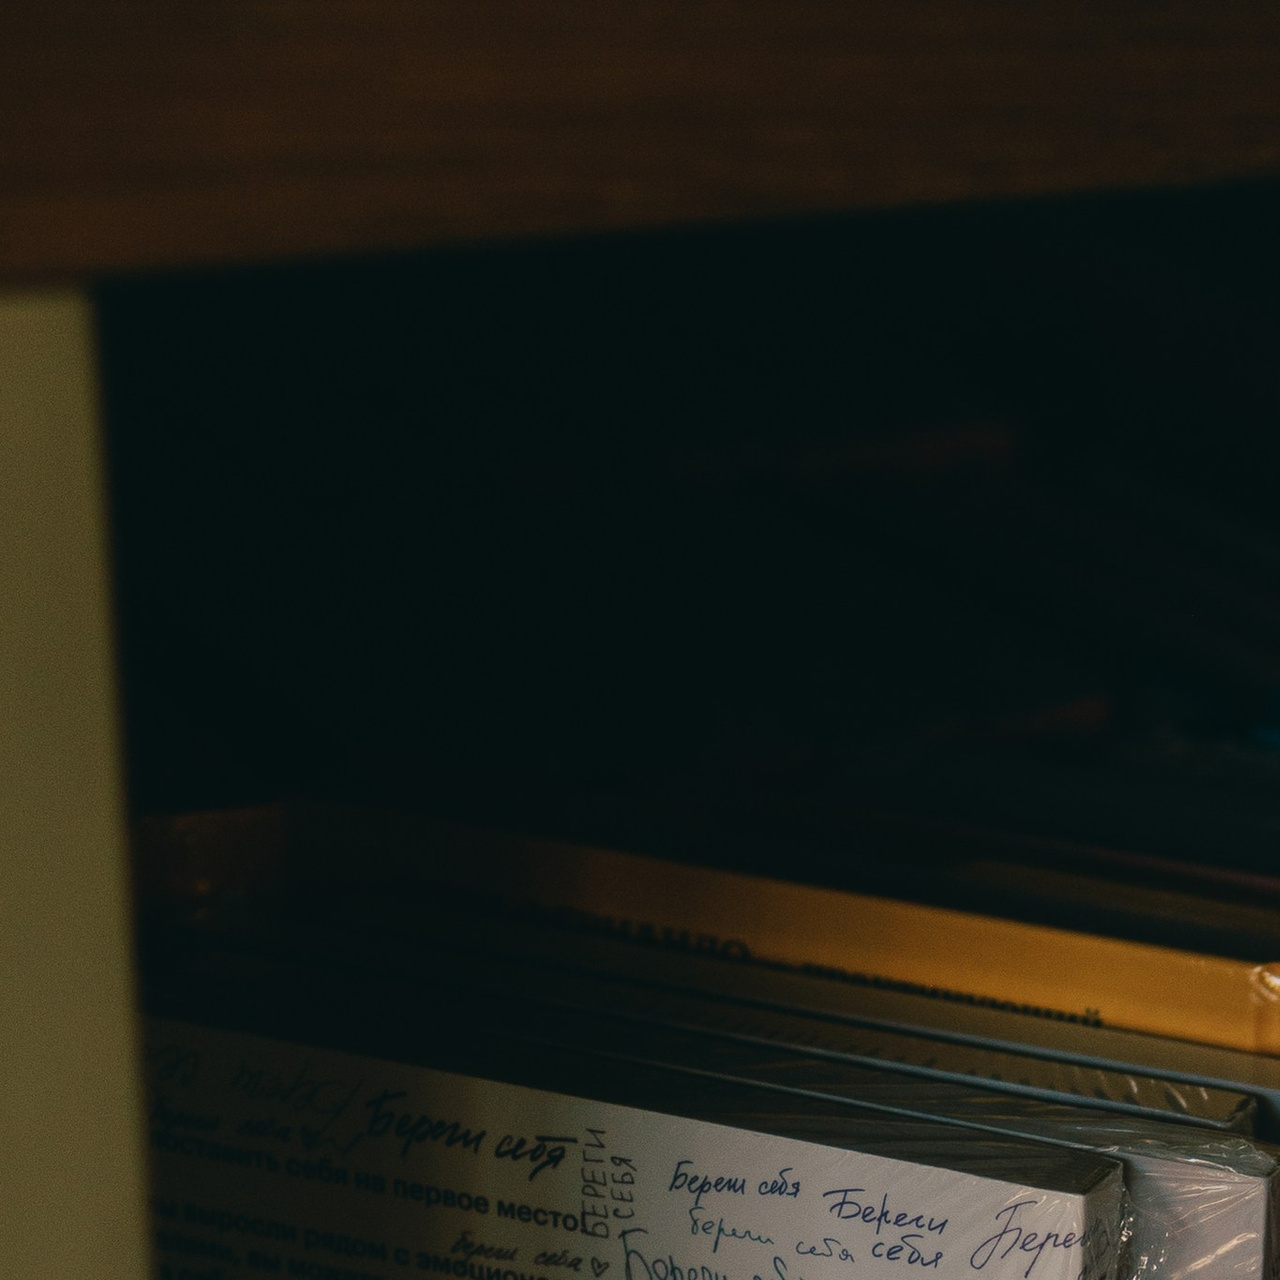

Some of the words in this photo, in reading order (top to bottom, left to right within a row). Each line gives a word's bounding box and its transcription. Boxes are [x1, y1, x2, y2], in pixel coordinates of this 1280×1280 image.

[366, 1089, 486, 1157] Береги
[495, 1134, 578, 1181] себя
[284, 1154, 349, 1186] себя
[352, 1168, 385, 1193] на
[391, 1175, 490, 1214] первое
[496, 1196, 584, 1232] место!
[581, 1127, 609, 1239] БЕРЕГИ
[611, 1155, 637, 1219] СЕБЯ
[669, 1160, 746, 1206] Береги
[758, 1168, 800, 1198] себя
[822, 1188, 948, 1235] Береги
[301, 1227, 387, 1263] рядом
[392, 1245, 411, 1267] с
[795, 1237, 855, 1263] себя
[872, 1234, 943, 1268] себя
